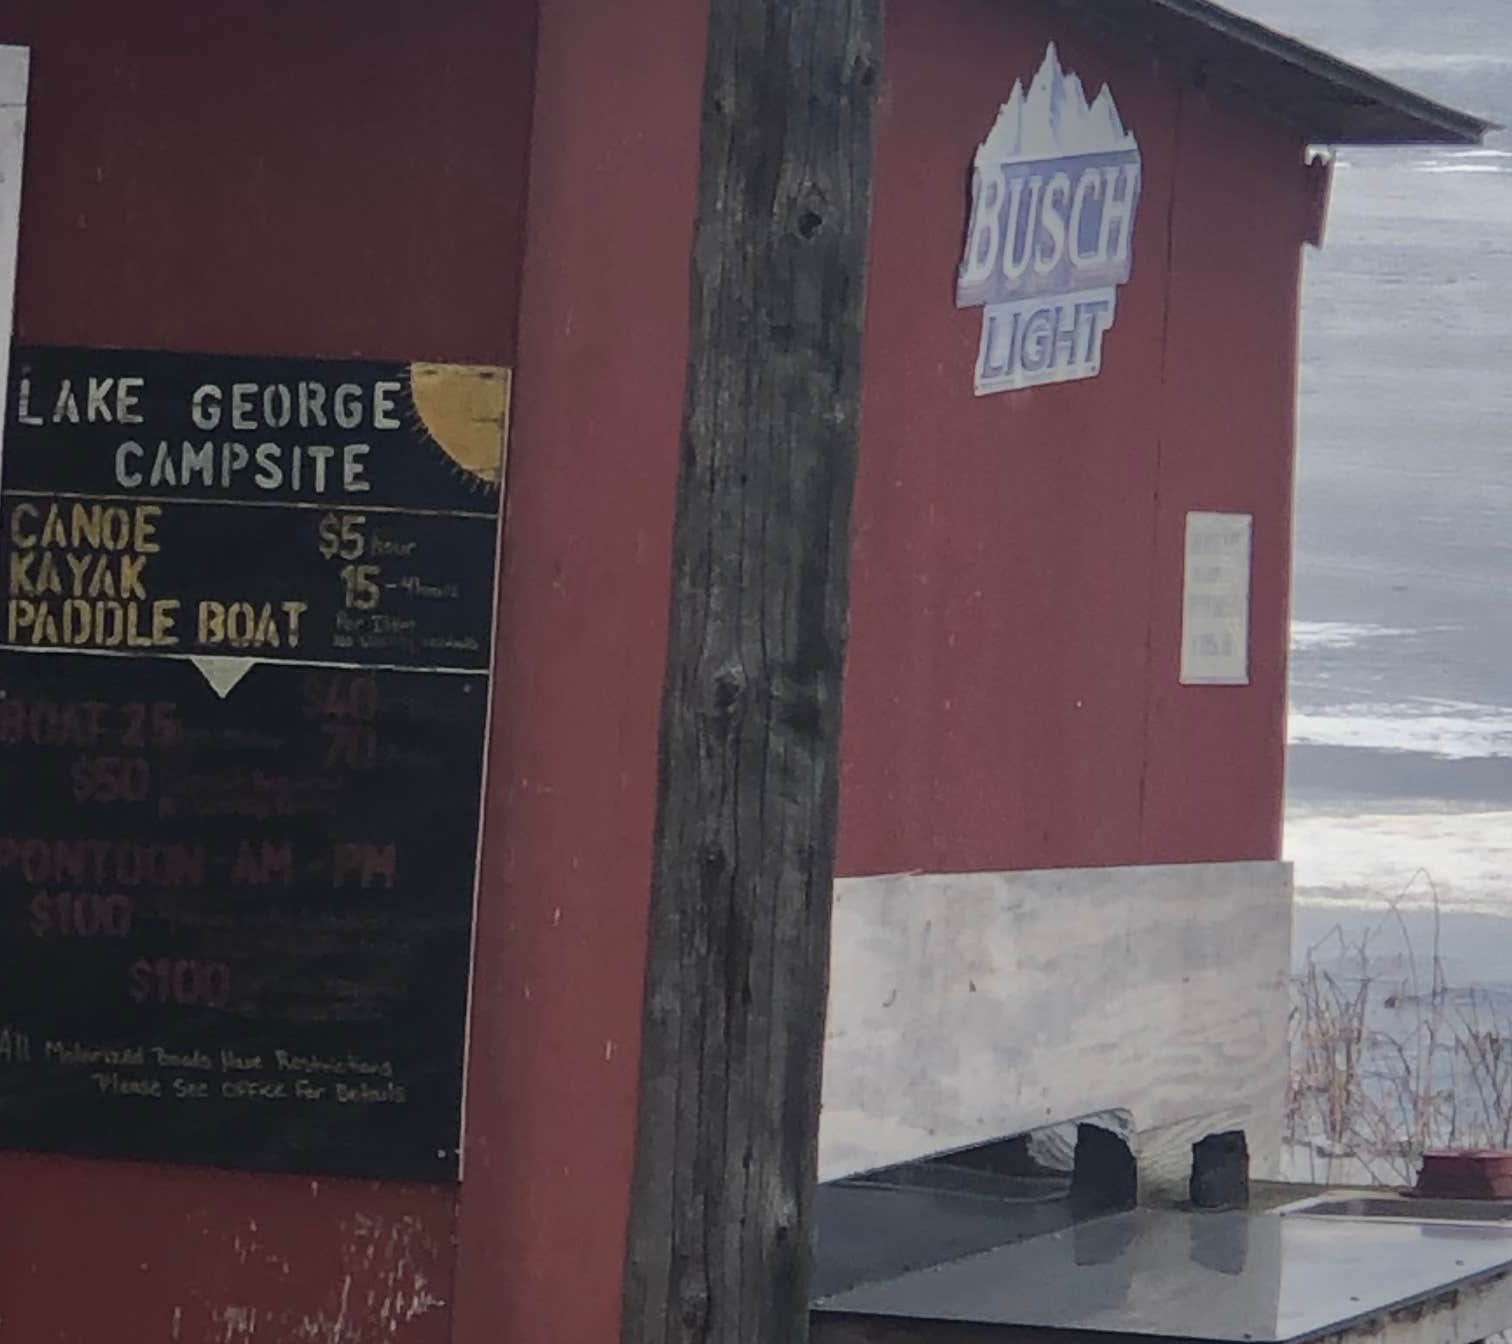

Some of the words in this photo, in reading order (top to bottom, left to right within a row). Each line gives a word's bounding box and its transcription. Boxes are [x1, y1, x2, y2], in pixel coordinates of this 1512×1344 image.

[967, 164, 1139, 282] BUSCH
[982, 301, 1109, 379] LIGHT
[18, 377, 145, 426] LAKE
[191, 380, 401, 431] GEORGE
[115, 440, 371, 493] CAMPSITE
[10, 502, 163, 553] CANOE
[319, 511, 367, 561] $5
[9, 551, 148, 599] KAYAK
[340, 564, 382, 610] 15
[7, 599, 181, 647] PADDLE
[198, 601, 308, 648] BOAT
[231, 838, 294, 888] AM
[331, 841, 398, 889] PM
[28, 889, 133, 940] $100
[128, 956, 233, 1009] $100
